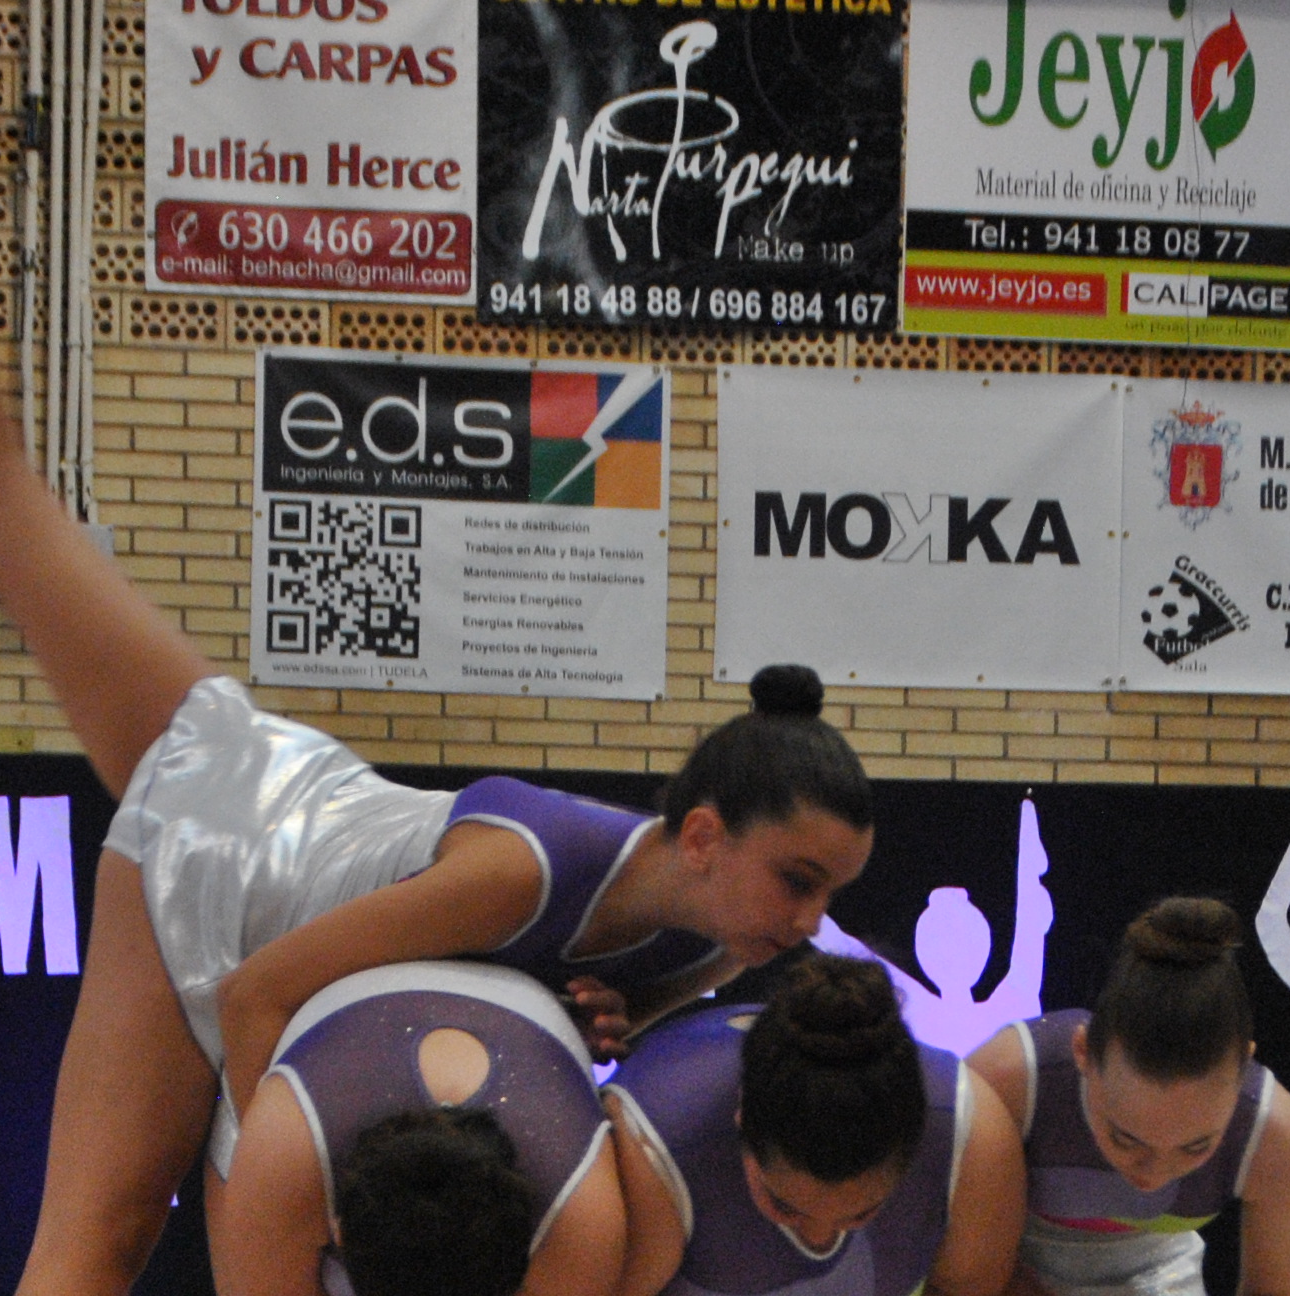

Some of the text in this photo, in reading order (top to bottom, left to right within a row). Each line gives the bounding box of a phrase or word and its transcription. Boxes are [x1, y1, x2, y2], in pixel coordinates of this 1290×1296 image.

[190, 37, 458, 87] y CARPAS
[167, 134, 462, 190] Julián Herce
[976, 168, 1257, 214] Material de oficina y Reciclaje
[218, 210, 457, 261] 630 466 202
[738, 235, 856, 267] Make up
[964, 218, 1251, 259] Tel.: 941 18 08 77
[162, 255, 467, 287] e-mail: behacha@gmail.com
[916, 271, 1092, 302] www.jeyjo.es
[490, 281, 542, 314] 941
[557, 283, 591, 317] 18
[601, 285, 636, 318] 48
[647, 286, 682, 318] 88
[709, 289, 761, 320] 696
[771, 291, 823, 322] 884
[834, 293, 887, 324] 167
[280, 377, 515, 469] e.d.s
[373, 470, 383, 486] y
[1260, 477, 1288, 510] de
[465, 517, 590, 533] Redes de distribución
[465, 542, 644, 561] Trabajos en Alta y Baja Tensión
[463, 566, 548, 581] Mantenimiento
[552, 569, 566, 581] de
[463, 591, 582, 608] Servicios Energético
[517, 617, 584, 631] Renovables
[462, 640, 520, 654] Proyectos
[523, 644, 537, 654] de
[378, 666, 428, 679] TUDELA
[461, 665, 514, 679] Sistemas
[518, 667, 532, 679] de
[535, 666, 557, 679] Alta
